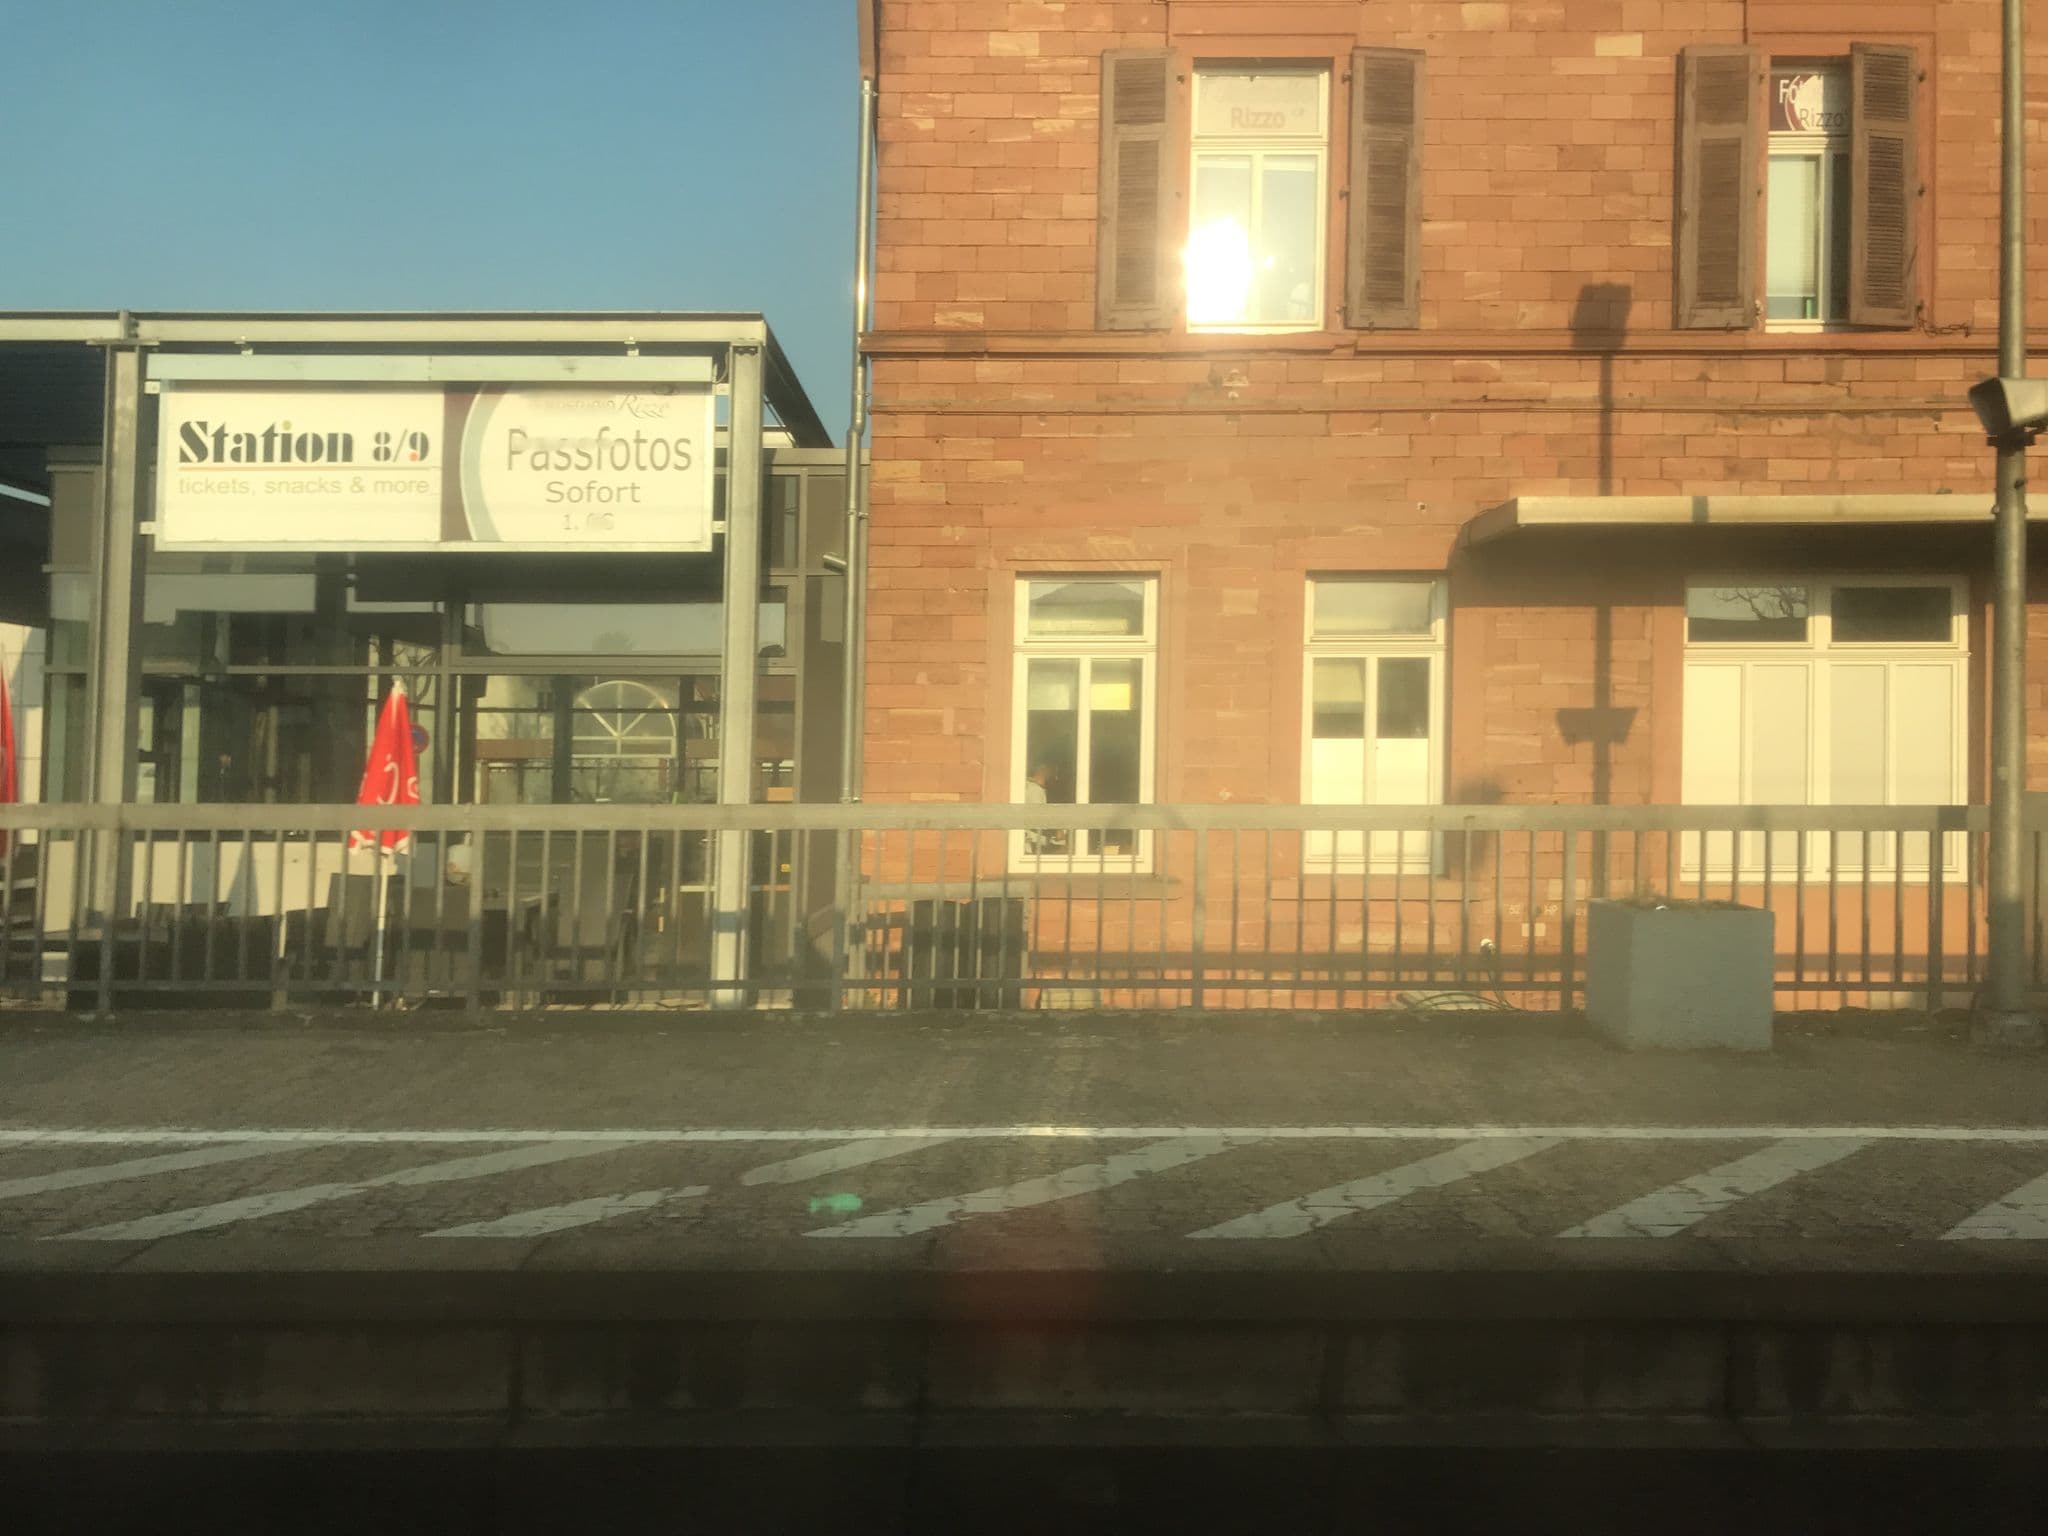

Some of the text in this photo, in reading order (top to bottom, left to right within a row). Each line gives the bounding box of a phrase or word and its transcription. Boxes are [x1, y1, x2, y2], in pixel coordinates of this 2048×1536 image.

[1231, 106, 1287, 129] Rizzo
[1799, 108, 1845, 127] Rizzo
[179, 421, 430, 463] Station 8/9
[507, 426, 692, 471] Passfotos
[178, 476, 430, 497] tickets, snacks & more
[546, 480, 641, 503] Sofort
